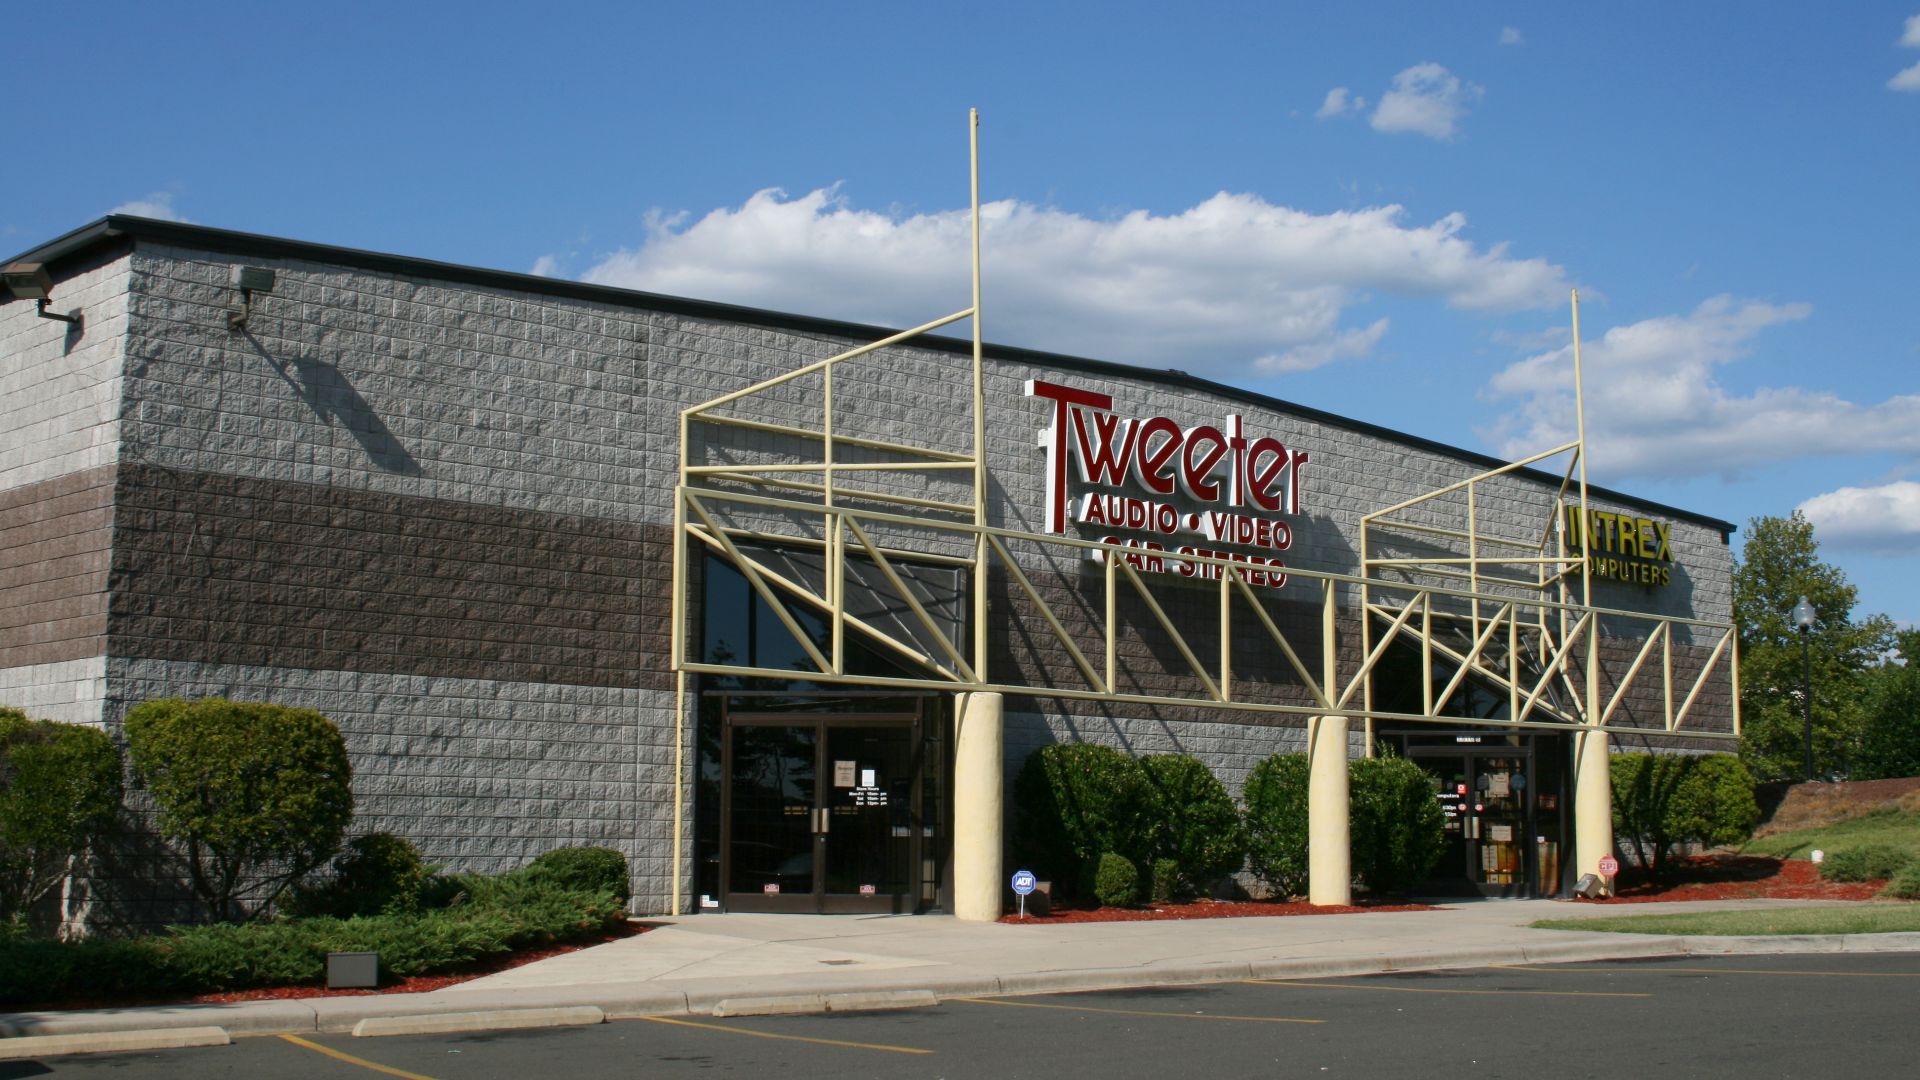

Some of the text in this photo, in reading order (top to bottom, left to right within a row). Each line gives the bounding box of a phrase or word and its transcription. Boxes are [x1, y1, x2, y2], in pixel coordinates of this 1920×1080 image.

[1026, 379, 1309, 534] Tweeter
[1080, 492, 1292, 550] AUDIO VIDEO
[1567, 505, 1673, 561] INTREX
[1099, 535, 1287, 589] CAR STEREO
[1015, 877, 1032, 886] ADT
[1599, 862, 1616, 870] CPI
